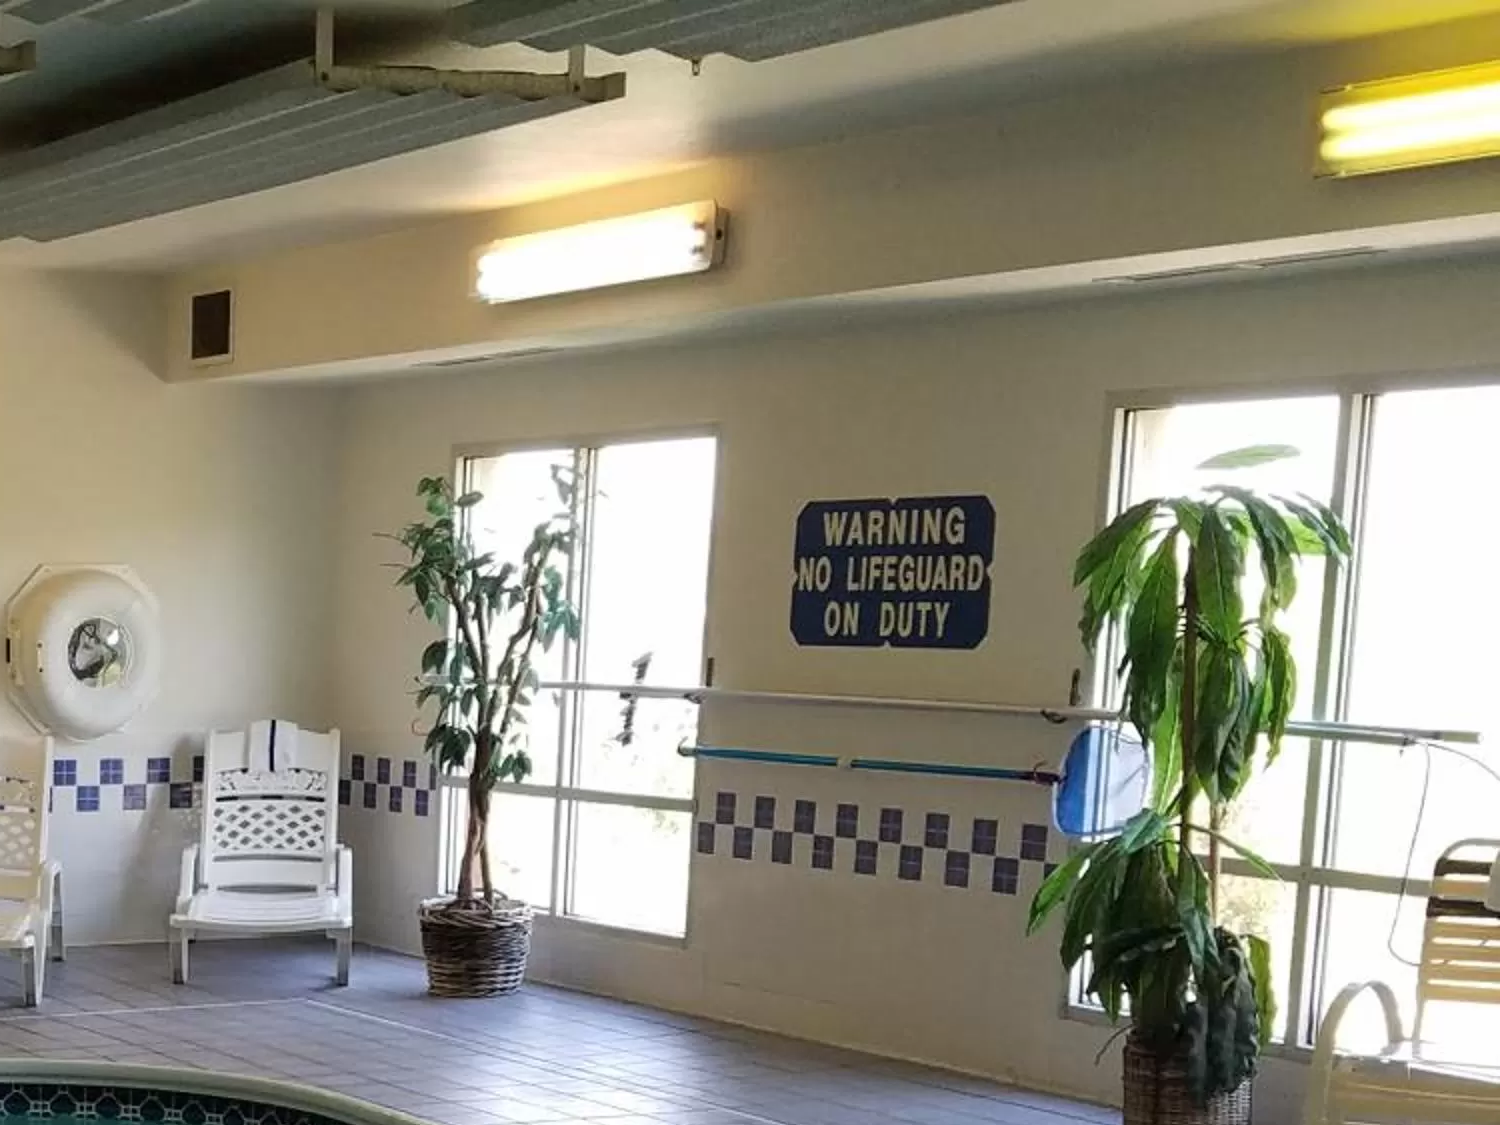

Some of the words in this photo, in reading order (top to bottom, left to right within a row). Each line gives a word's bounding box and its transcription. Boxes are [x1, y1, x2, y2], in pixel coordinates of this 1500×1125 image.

[823, 506, 966, 547] WARNING
[798, 556, 832, 593] NO
[846, 554, 985, 592] LIFEGUARD
[823, 601, 861, 637] ON
[879, 601, 950, 638] DUTY
